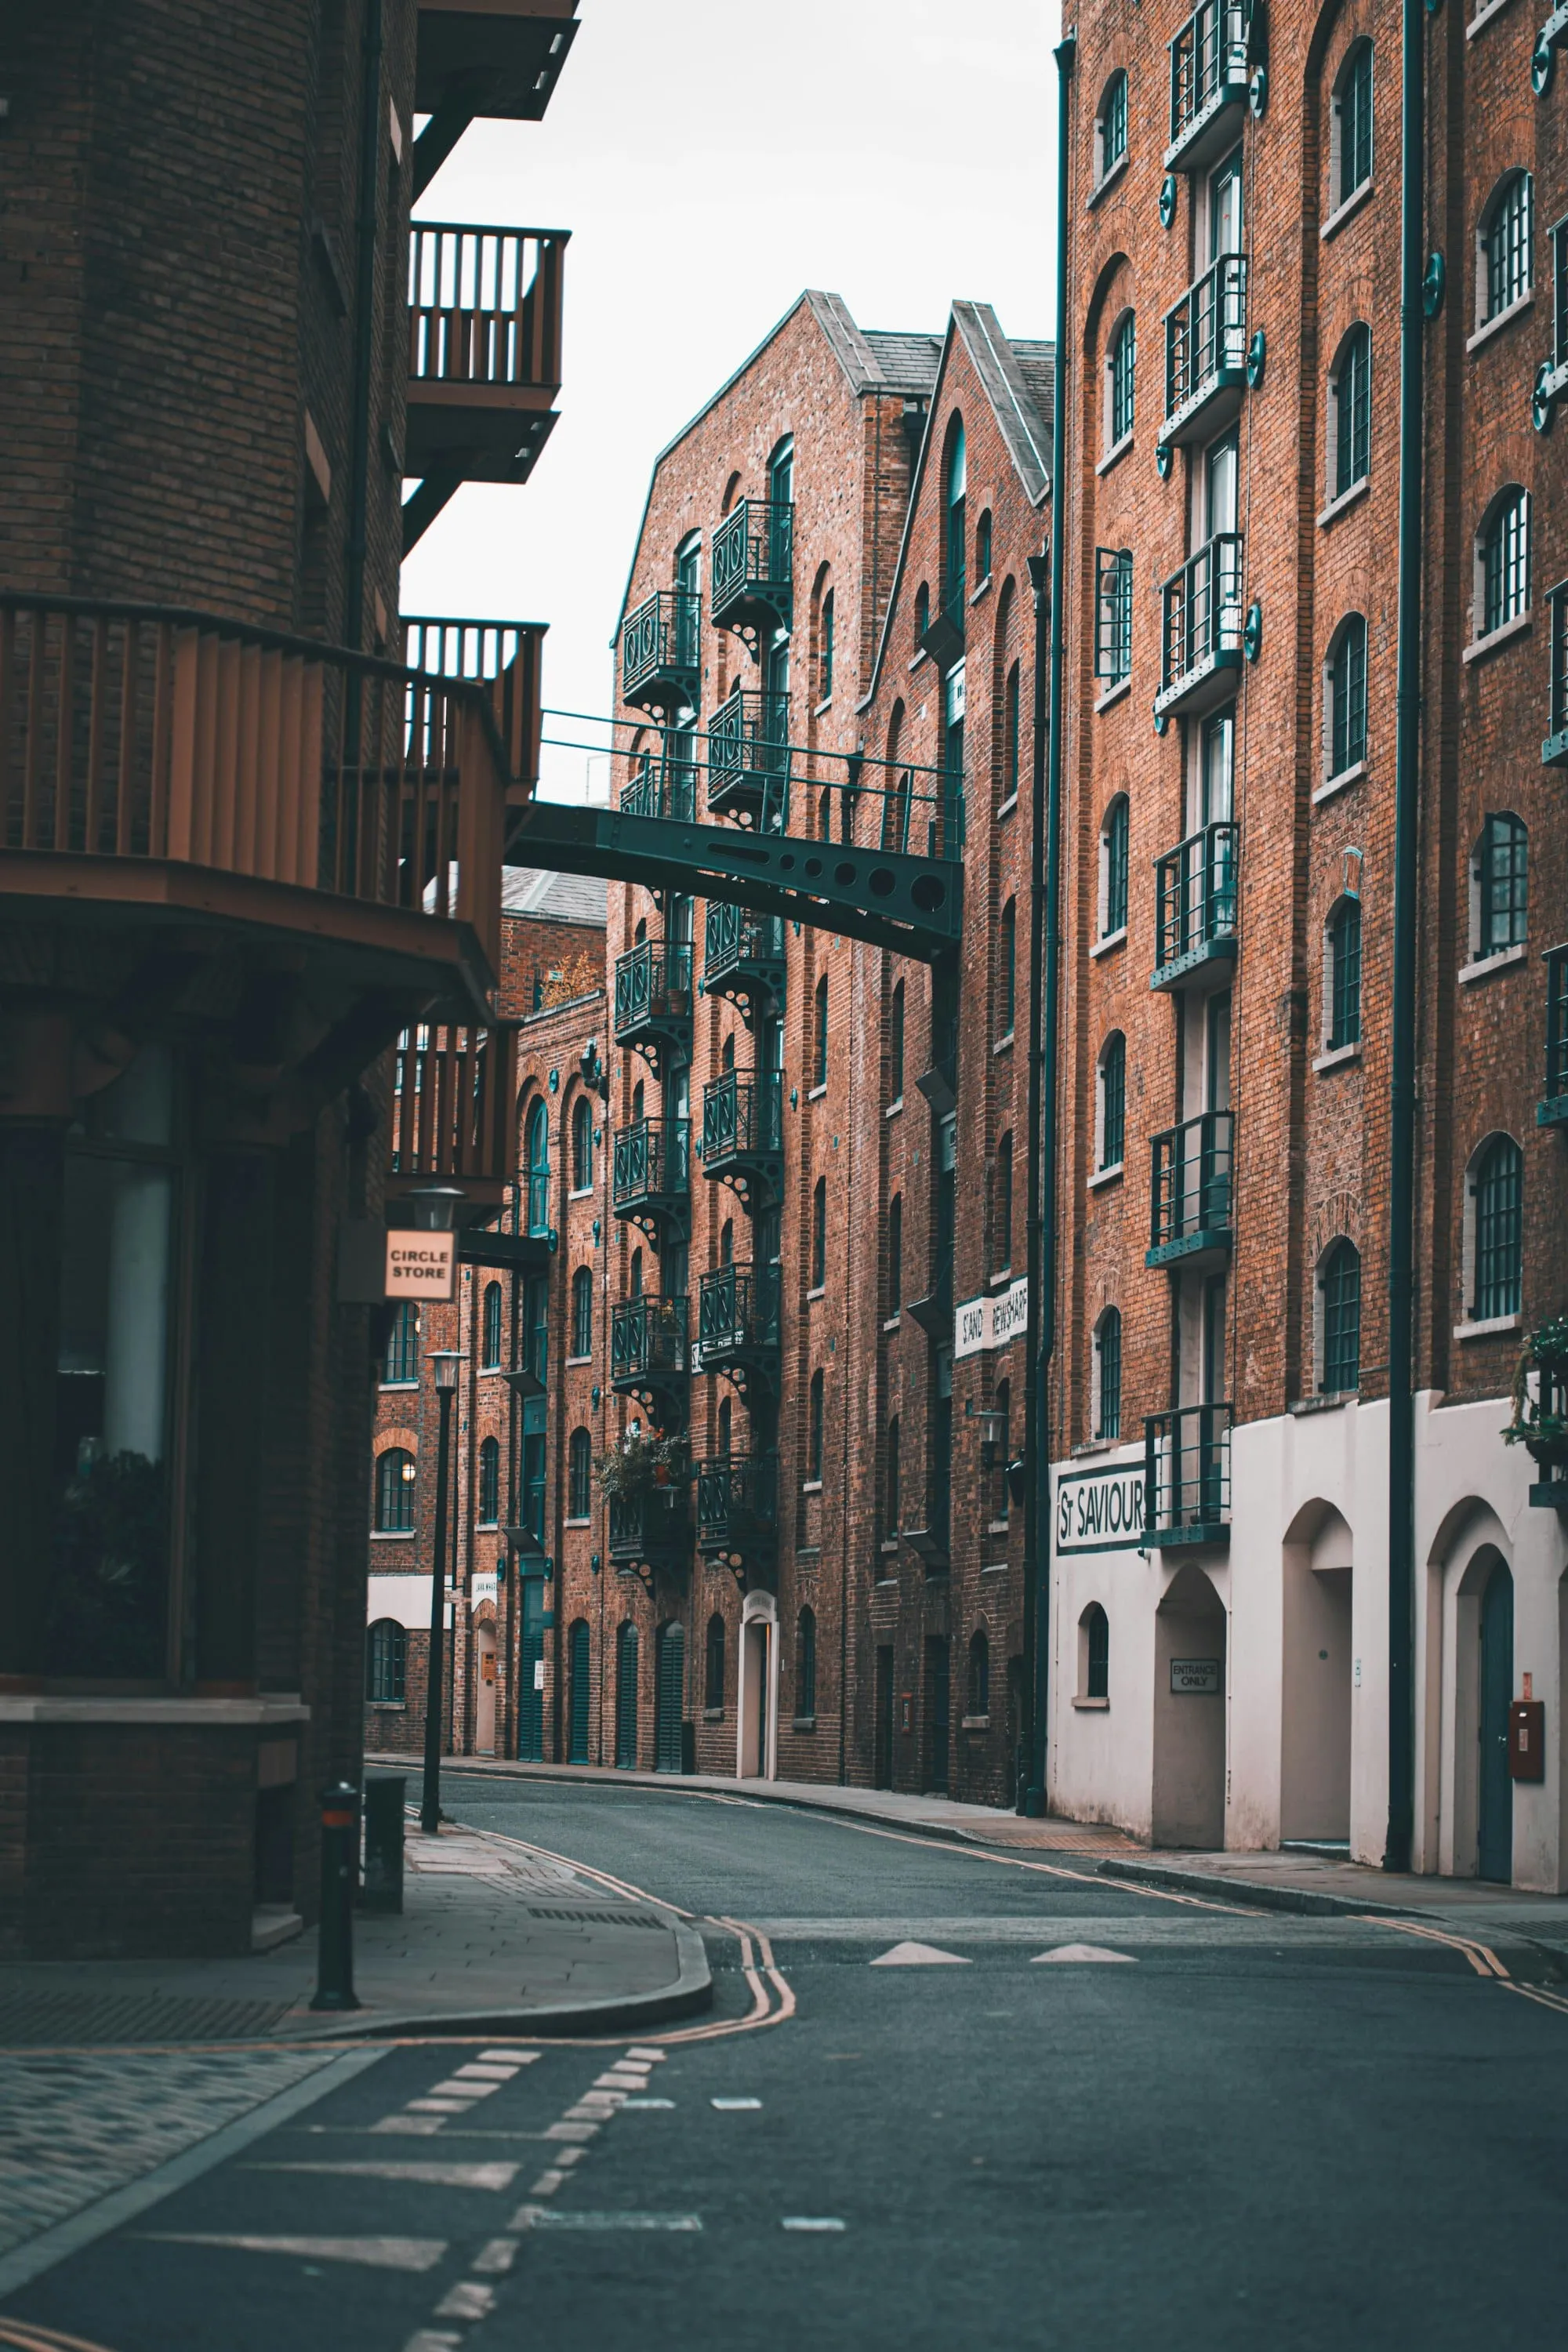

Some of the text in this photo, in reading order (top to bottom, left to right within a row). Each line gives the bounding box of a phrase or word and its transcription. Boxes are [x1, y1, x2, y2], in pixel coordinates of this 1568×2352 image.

[390, 1250, 448, 1263] CIRCLE
[393, 1266, 445, 1279] STORE
[1061, 1479, 1146, 1540] ST SAVIOUR
[1173, 1665, 1216, 1675] ENTRANCE
[1181, 1676, 1208, 1686] ONLY
